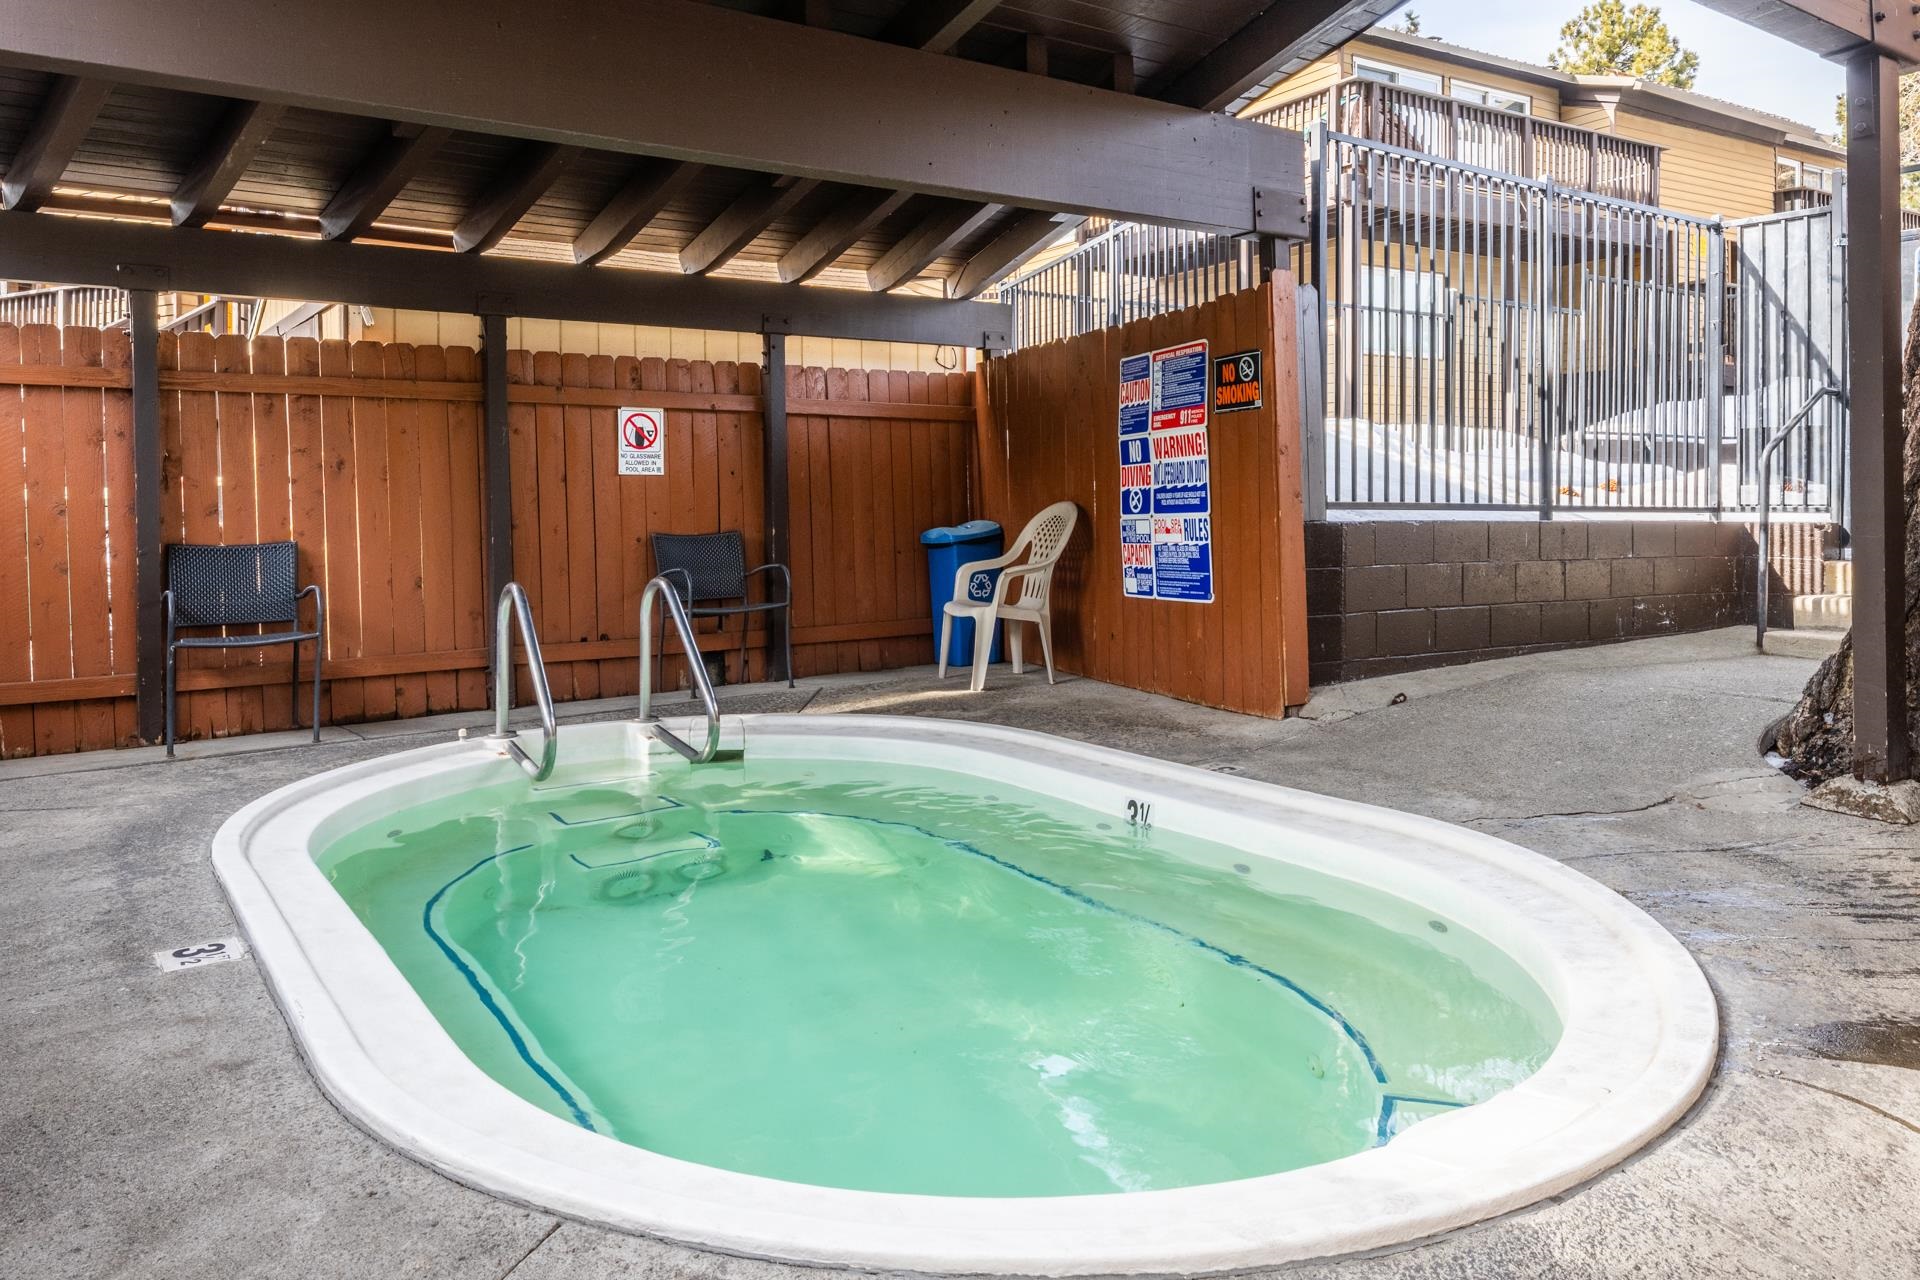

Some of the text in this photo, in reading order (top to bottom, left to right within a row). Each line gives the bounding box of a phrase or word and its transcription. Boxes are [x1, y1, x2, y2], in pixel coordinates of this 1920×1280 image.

[1176, 346, 1202, 357] RESPIRATION
[1222, 362, 1235, 383] NO
[1120, 378, 1150, 404] CAUTION
[1216, 381, 1259, 405] SMOKING
[1153, 413, 1176, 421] EMERGENCY
[1179, 409, 1191, 425] 911
[1129, 440, 1142, 463] NO
[1153, 431, 1207, 460] WARNING!
[1121, 464, 1151, 487] DIVING
[1160, 461, 1185, 486] LIFEGUARD
[1186, 460, 1194, 484] ON
[1195, 458, 1207, 483] DUTY
[1171, 518, 1181, 529] SPA
[1183, 518, 1209, 541] RULES
[1136, 534, 1151, 543] POOL
[1122, 544, 1152, 566] CAPACITY
[1126, 567, 1135, 578] SPA
